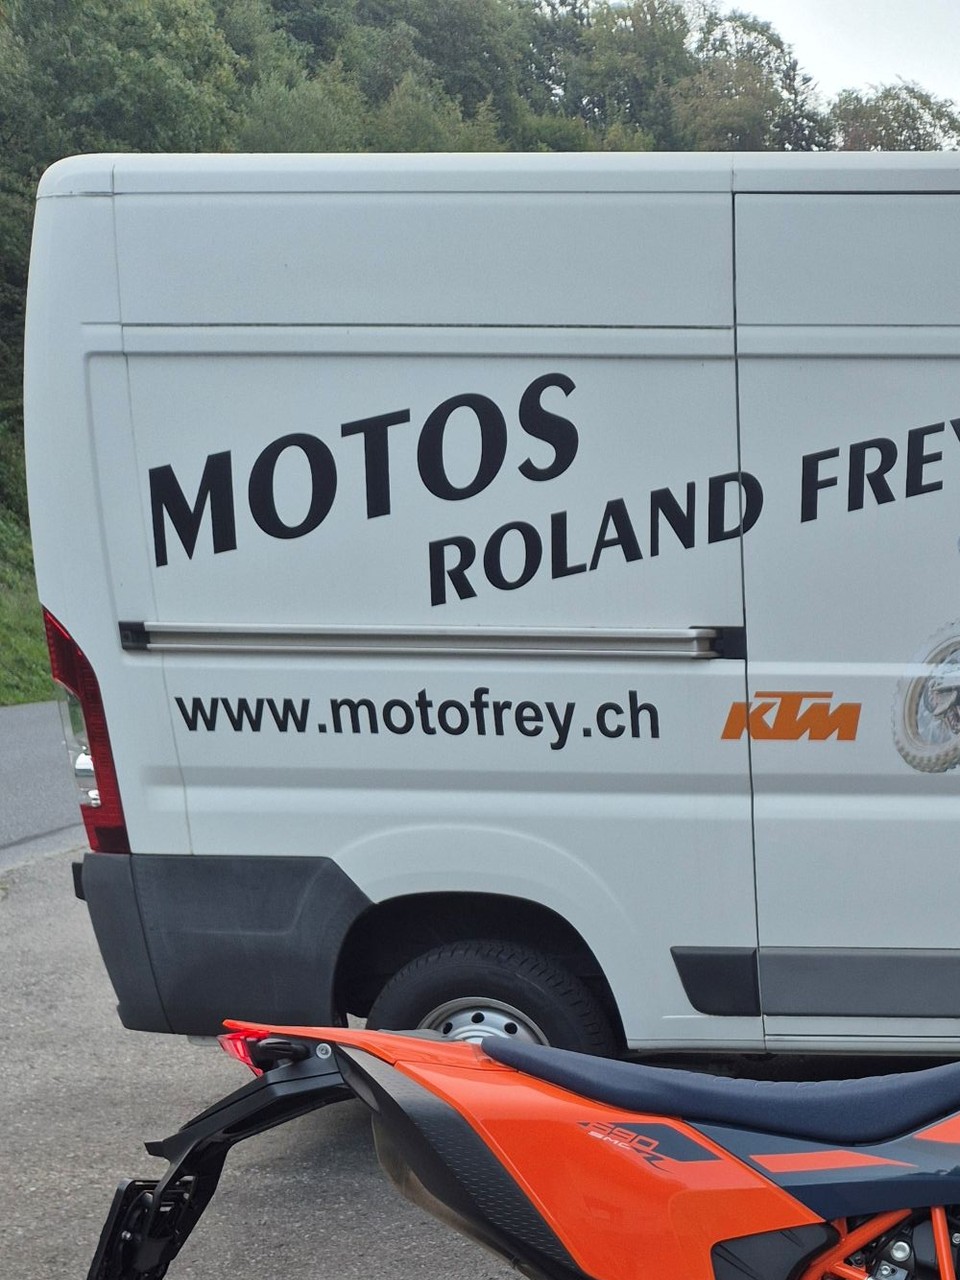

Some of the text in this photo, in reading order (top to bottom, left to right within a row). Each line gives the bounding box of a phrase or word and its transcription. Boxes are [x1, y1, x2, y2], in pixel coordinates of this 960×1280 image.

[148, 372, 579, 567] MOTOS
[428, 471, 764, 606] ROLAND
[174, 688, 660, 751] www.motofrey.ch
[719, 691, 862, 742] KTM
